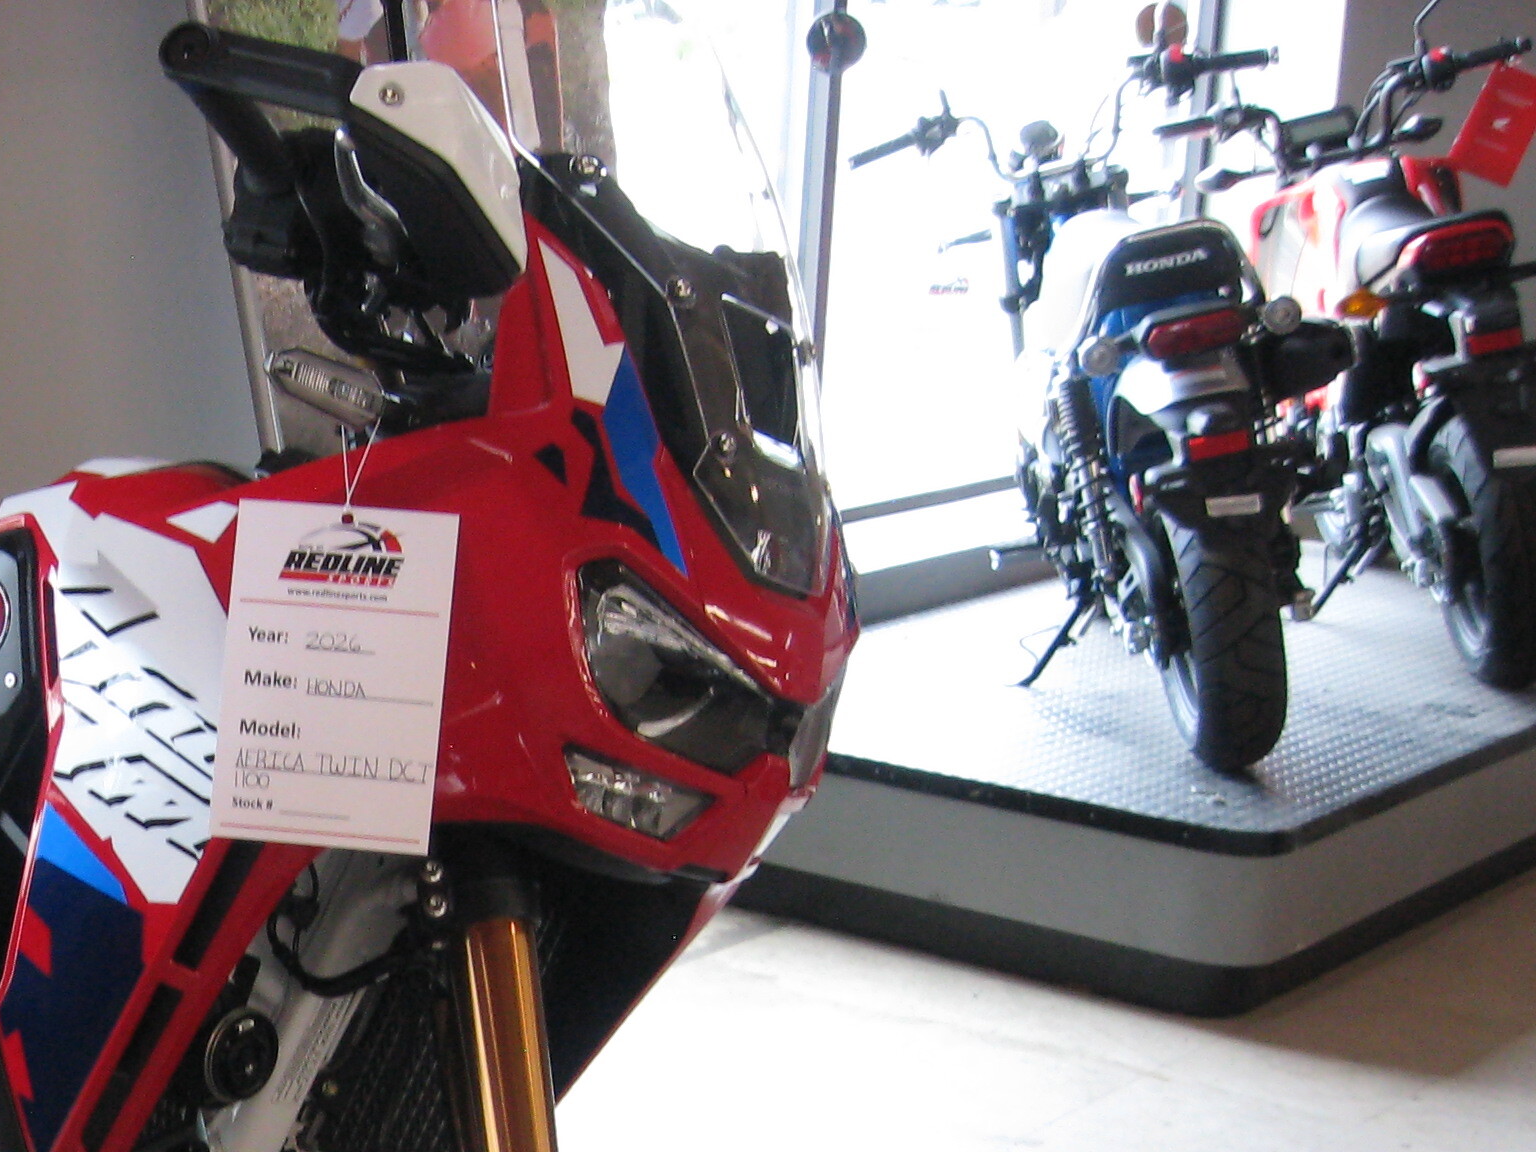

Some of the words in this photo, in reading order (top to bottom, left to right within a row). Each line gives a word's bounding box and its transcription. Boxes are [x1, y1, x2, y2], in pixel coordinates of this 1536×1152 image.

[1125, 247, 1208, 276] HONDA
[283, 549, 405, 577] REDLINE
[325, 572, 399, 588] SPORTS
[248, 625, 288, 644] Year:
[304, 631, 362, 652] 2026
[244, 669, 297, 689] Make:
[305, 677, 367, 700] HONDA
[239, 718, 301, 739] Model:
[235, 746, 305, 773] AFRICA
[316, 752, 379, 780] TWIN
[388, 757, 434, 785] DCT
[234, 770, 271, 789] 1100
[231, 796, 263, 810] Stock
[265, 798, 274, 810] #
